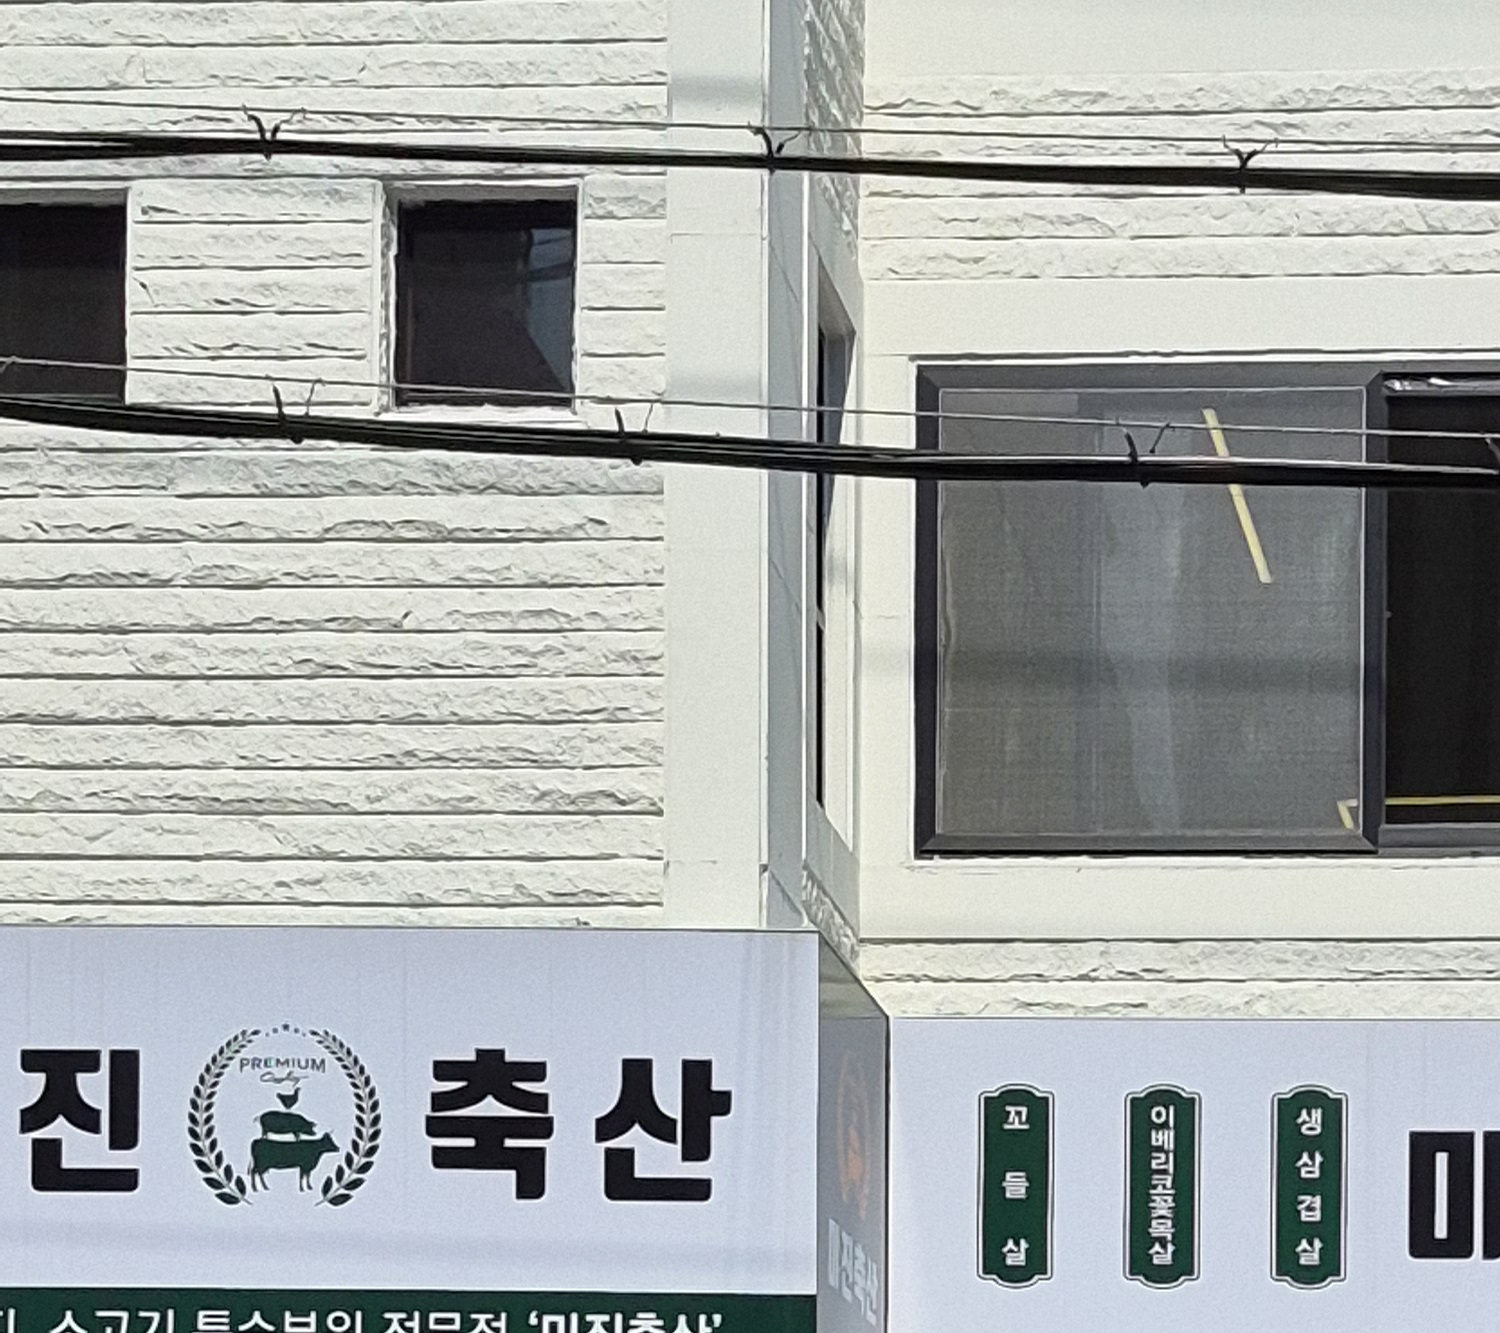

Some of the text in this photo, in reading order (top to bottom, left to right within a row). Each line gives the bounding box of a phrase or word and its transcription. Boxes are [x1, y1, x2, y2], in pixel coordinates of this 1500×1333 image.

[18, 1045, 733, 1203] 진 축산
[239, 1057, 326, 1074] PREMIUM
[1002, 1105, 1030, 1268] 꼬들살
[1148, 1105, 1176, 1266] 이베리코꽃목살
[1296, 1106, 1323, 1267] 생삼겹살
[827, 1216, 878, 1328] 미진축산
